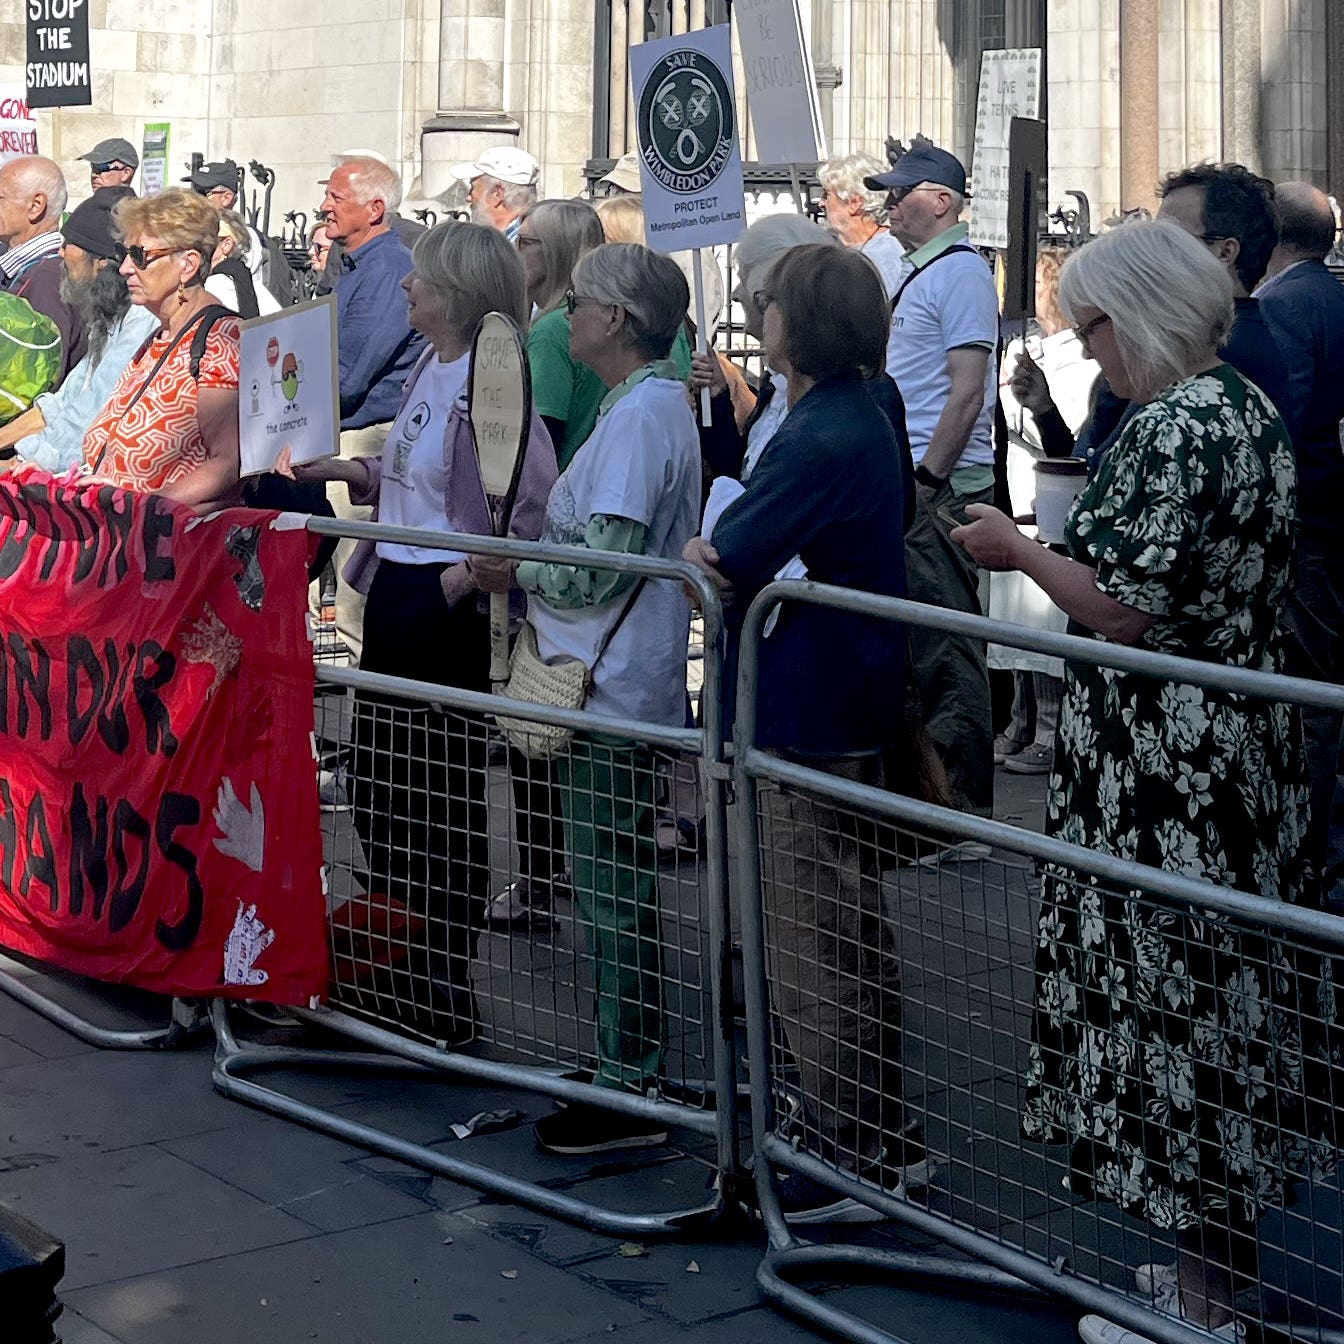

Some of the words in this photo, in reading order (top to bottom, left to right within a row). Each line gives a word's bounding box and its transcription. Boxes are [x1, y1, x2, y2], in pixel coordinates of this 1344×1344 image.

[36, 27, 72, 51] THE
[665, 53, 697, 71] SAVE
[27, 62, 88, 88] STADIUM
[644, 145, 711, 191] WIMBLEDON
[708, 135, 733, 176] PARK
[674, 196, 719, 214] PROTECT
[650, 216, 698, 233] Metropolitan
[699, 213, 720, 227] Open
[721, 210, 741, 222] Land
[266, 421, 278, 435] the
[279, 416, 308, 433] concrete
